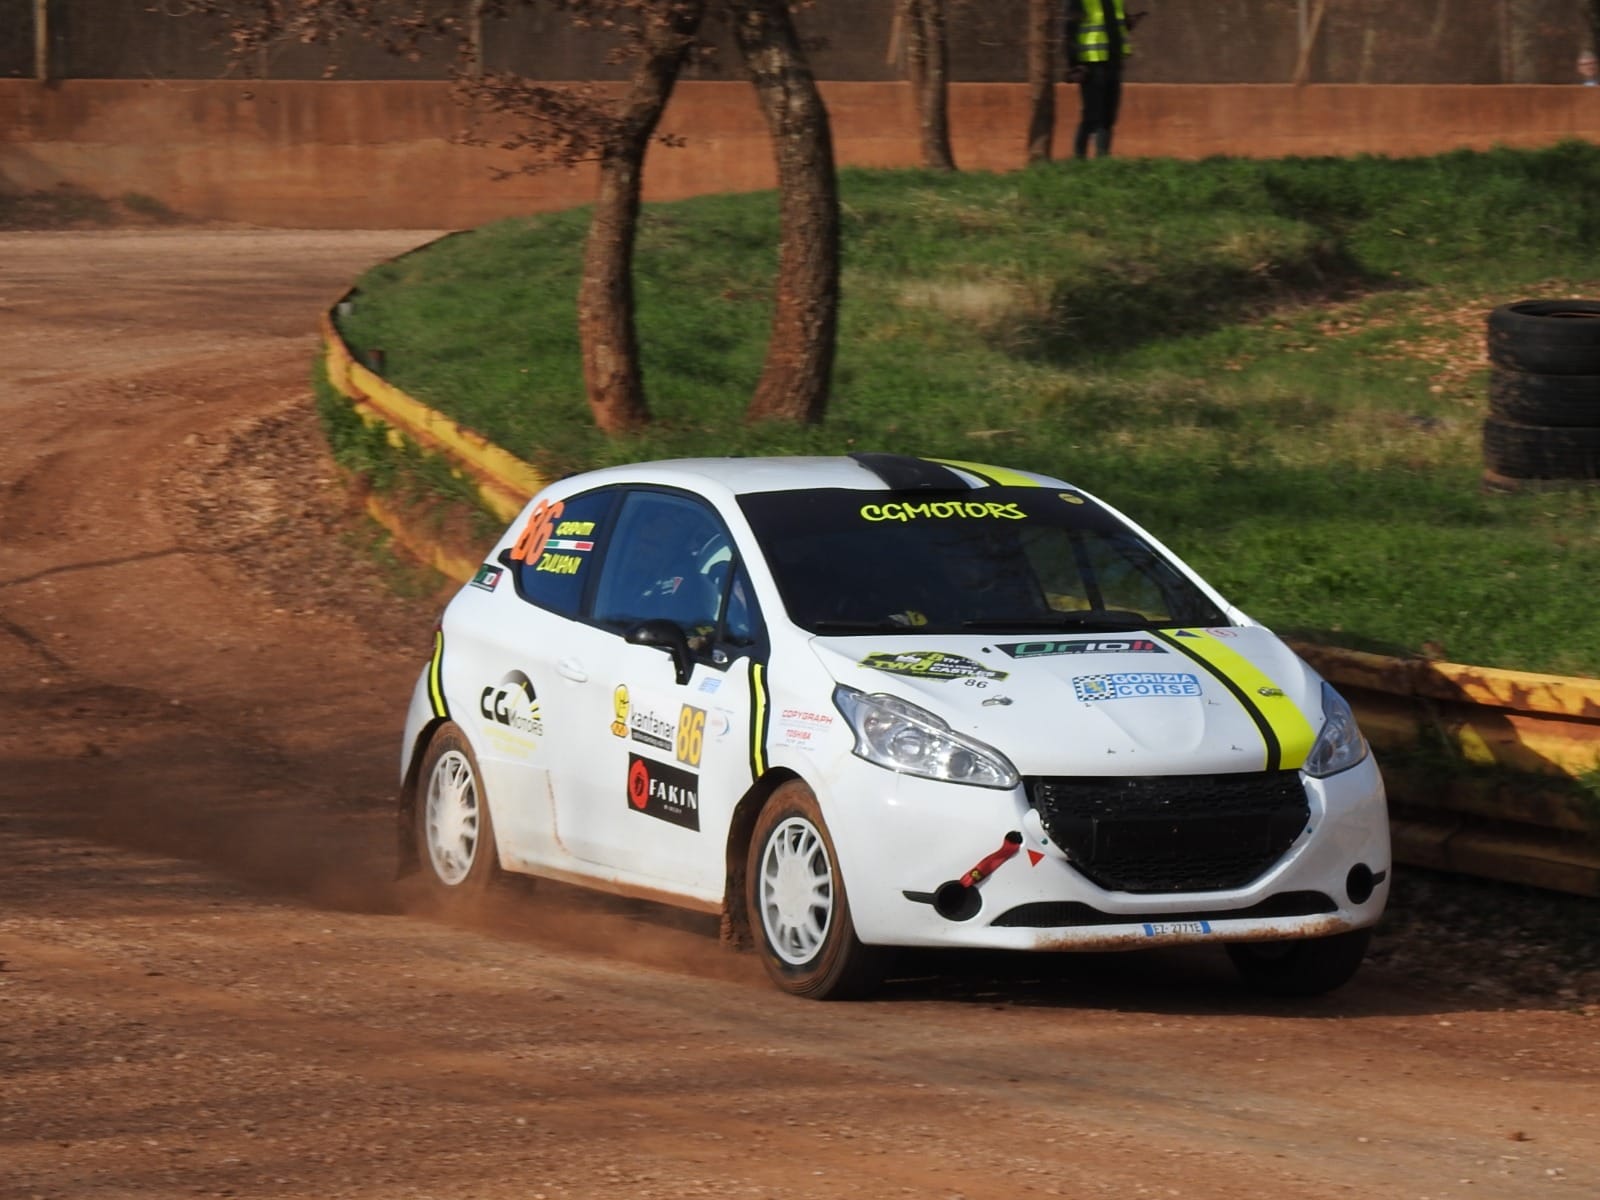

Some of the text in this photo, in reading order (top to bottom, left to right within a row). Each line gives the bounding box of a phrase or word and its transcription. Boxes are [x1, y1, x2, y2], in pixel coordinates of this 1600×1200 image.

[860, 502, 1028, 522] CGMOTORS
[510, 499, 565, 566] 86
[874, 660, 929, 674] TWO
[1111, 673, 1196, 684] GORIZIA
[964, 678, 989, 689] 86
[1120, 684, 1197, 695] CORSE
[481, 686, 510, 726] CG
[631, 703, 675, 741] kanfanar
[677, 706, 705, 766] 86
[649, 778, 697, 810] FAKIN
